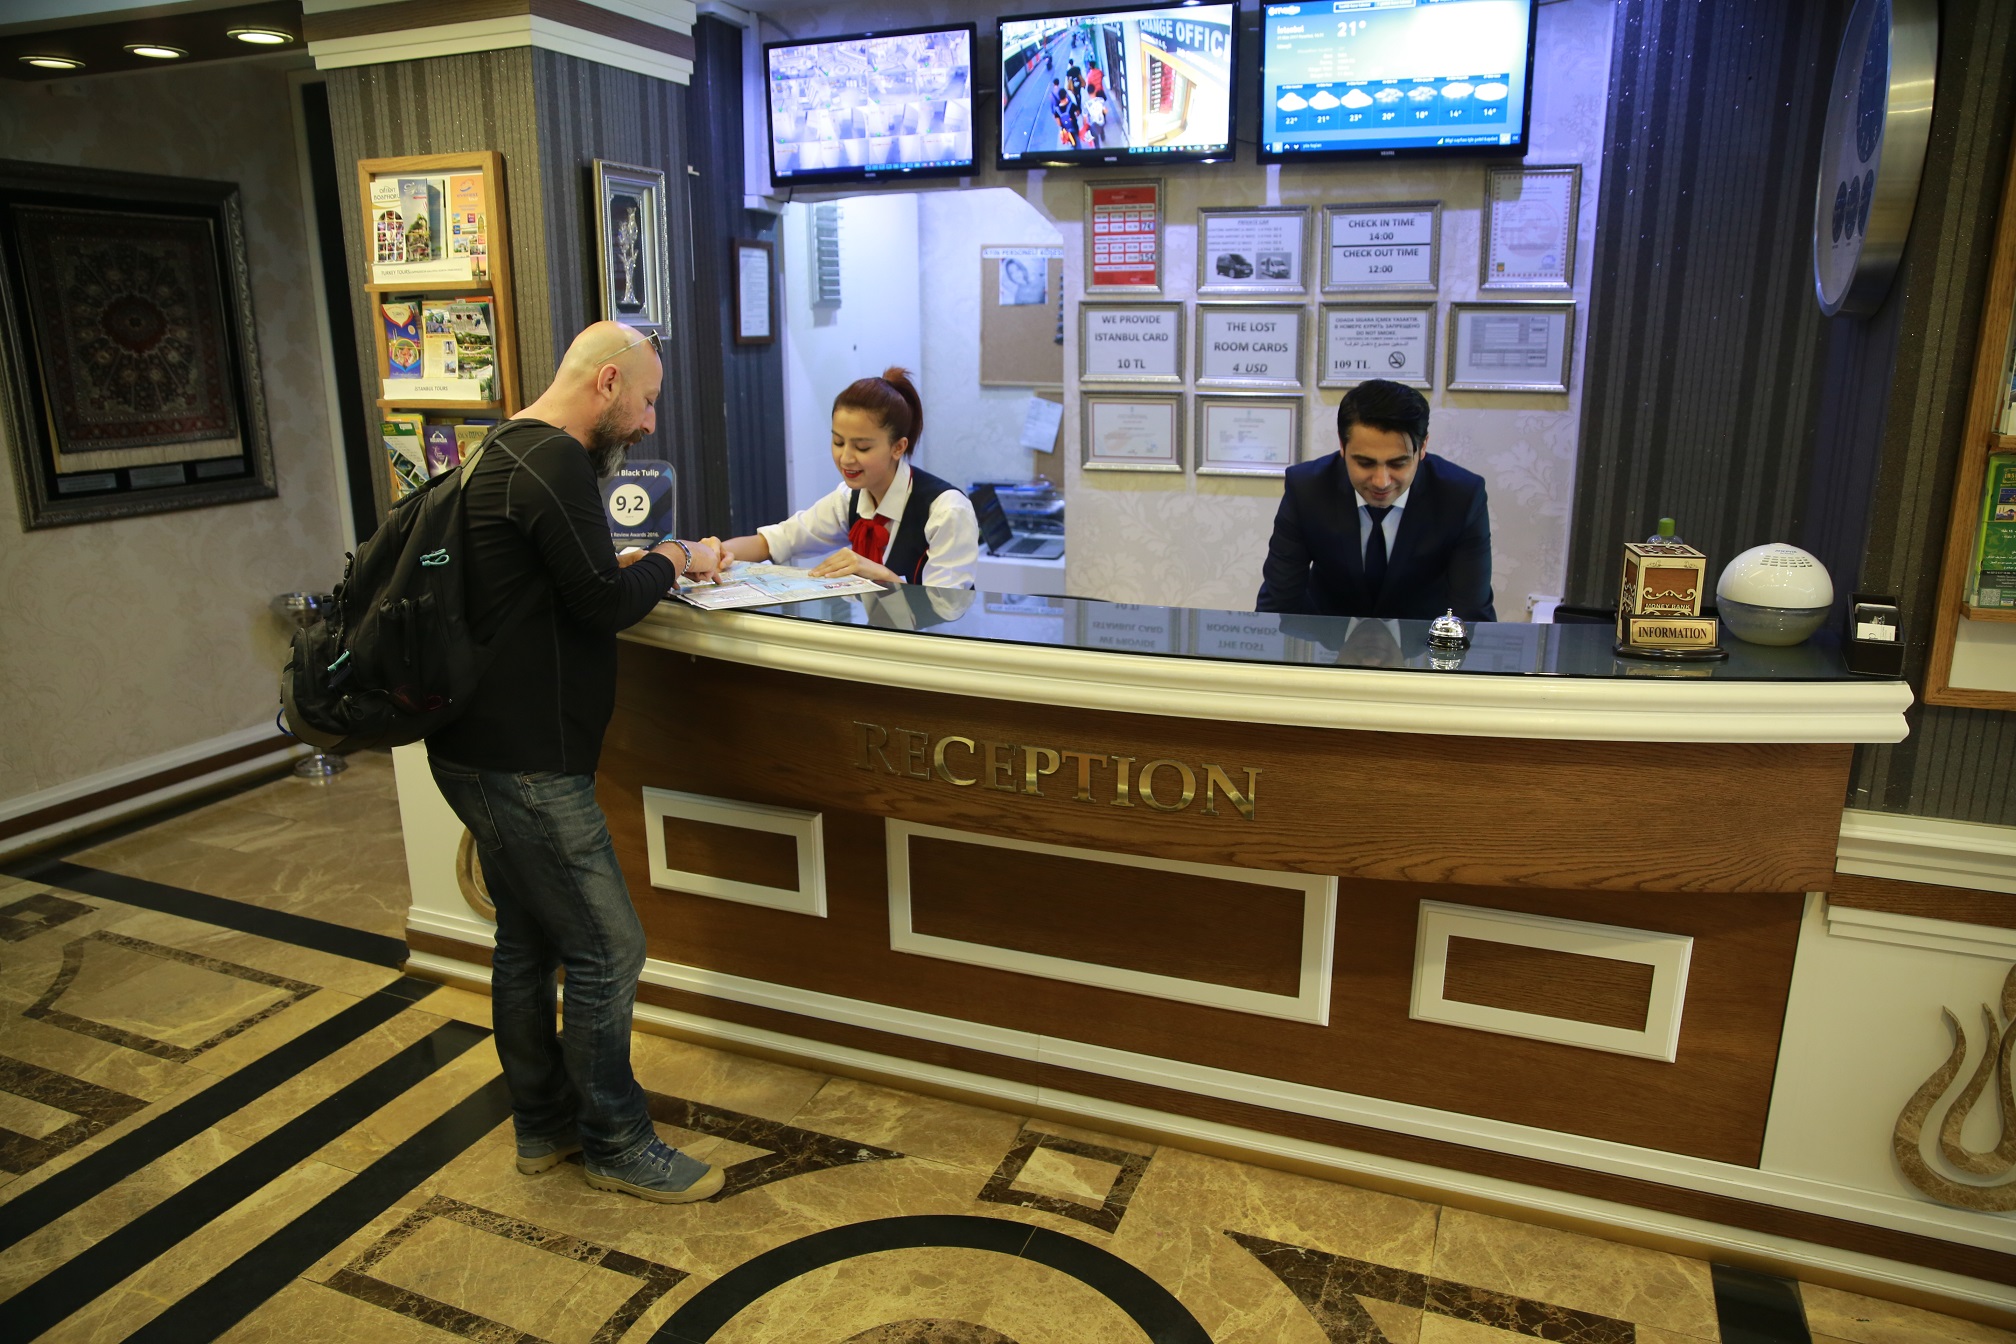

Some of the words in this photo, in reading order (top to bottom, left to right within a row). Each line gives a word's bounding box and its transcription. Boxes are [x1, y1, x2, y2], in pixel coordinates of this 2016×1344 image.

[1348, 219, 1378, 228] CHECK
[1380, 219, 1390, 227] IN
[1391, 218, 1415, 227] TIME
[1369, 232, 1394, 241] 14:00
[1343, 248, 1372, 258] CHECK
[1374, 248, 1394, 257] OUT
[1395, 248, 1419, 257] TIME
[1368, 265, 1393, 274] 12:00
[1101, 315, 1117, 324] WE
[1119, 315, 1161, 324] PROVIDE
[1226, 322, 1247, 332] THE
[1250, 322, 1277, 332] LOST
[1094, 333, 1140, 342] ISTANBUL
[1142, 333, 1169, 342] CARD
[1213, 342, 1249, 352] ROOM
[1252, 342, 1288, 353] CARDS
[1117, 359, 1131, 369] 10
[1132, 359, 1146, 369] TL
[1232, 364, 1239, 373] 4
[1245, 363, 1268, 374] USD
[1334, 360, 1352, 369] 109
[621, 469, 640, 477] Black
[641, 469, 660, 478] Tulip
[615, 496, 644, 514] 9,2
[1638, 626, 1707, 639] INFORMATION
[853, 720, 1263, 820] RECEPTION
